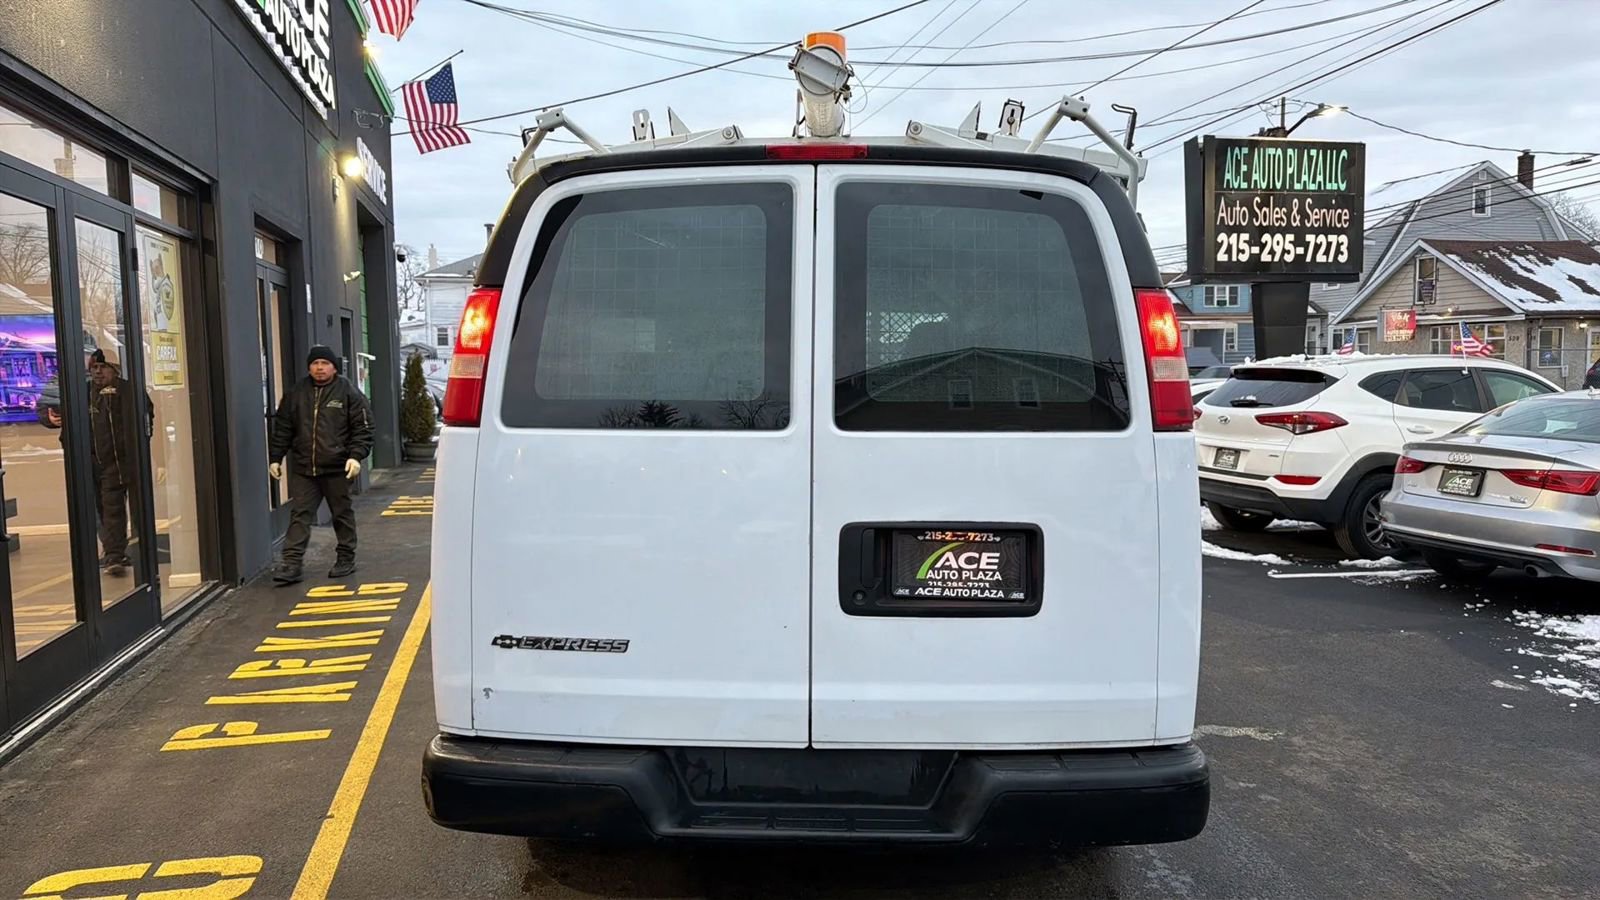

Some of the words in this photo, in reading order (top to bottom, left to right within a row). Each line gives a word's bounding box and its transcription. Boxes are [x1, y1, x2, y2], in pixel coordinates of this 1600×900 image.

[298, 27, 336, 110] PLAZA
[1223, 146, 1248, 189] ACE
[1251, 147, 1283, 190] AUTO
[1216, 196, 1249, 226] Auto
[1253, 196, 1287, 228] Sales
[1291, 198, 1301, 228] &
[1304, 198, 1350, 228] Service
[1216, 232, 1349, 263] 215-295-7273
[1452, 477, 1474, 485] ACE
[934, 551, 1001, 569] ACE
[926, 569, 959, 580] AUTO
[962, 570, 1002, 581] PLAZA
[915, 587, 942, 596] ACE
[943, 588, 970, 597] AUTO
[971, 588, 1004, 598] PLAZA
[521, 636, 628, 652] EXPRESS
[160, 582, 409, 751] PARKING
